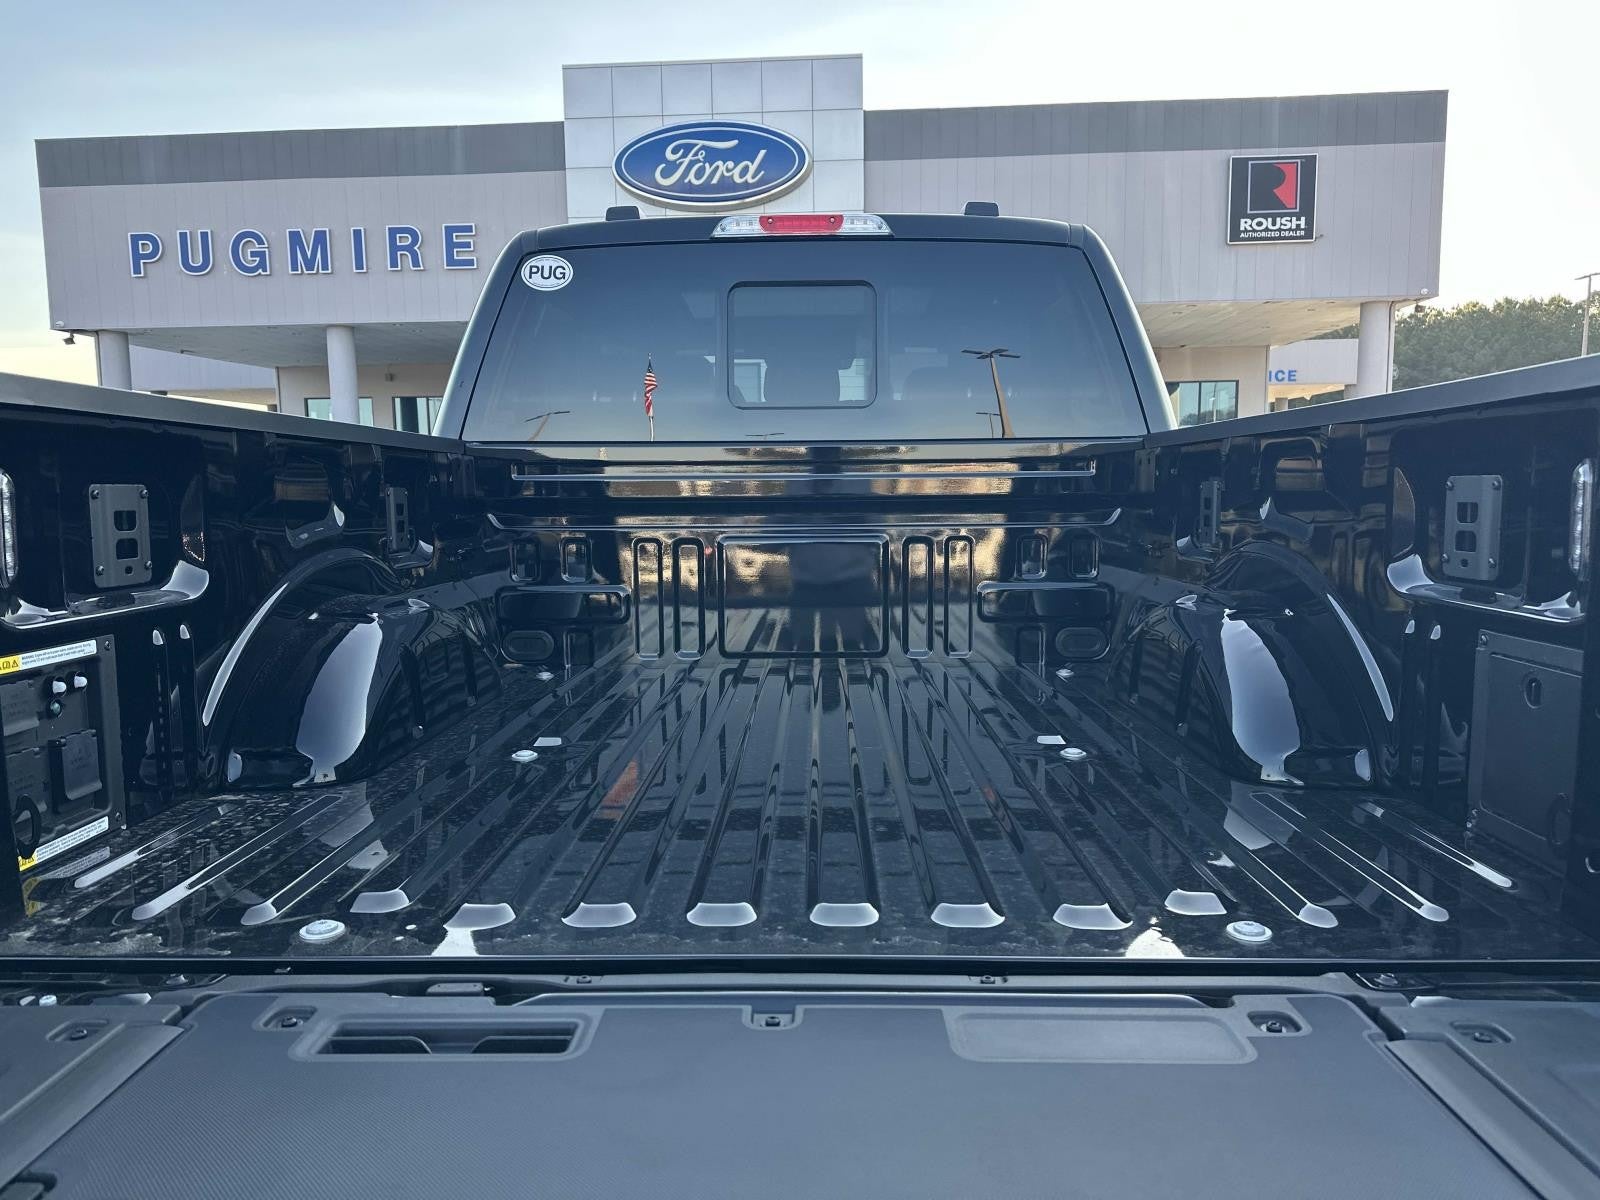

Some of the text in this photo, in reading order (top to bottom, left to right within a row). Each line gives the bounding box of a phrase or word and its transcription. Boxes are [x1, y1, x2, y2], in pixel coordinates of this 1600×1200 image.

[655, 139, 767, 186] Ford
[1240, 216, 1306, 231] ROUSH
[127, 223, 478, 277] PUGMIRE
[528, 264, 567, 280] PUG
